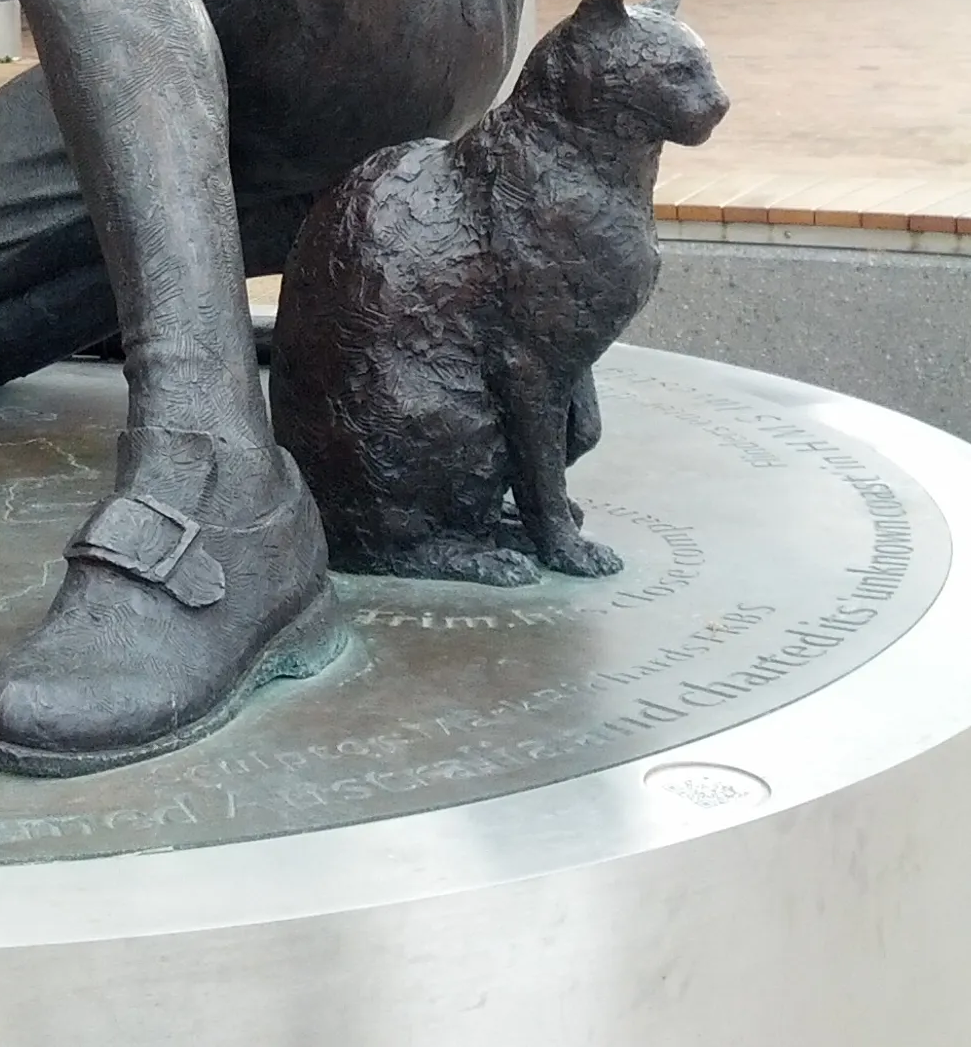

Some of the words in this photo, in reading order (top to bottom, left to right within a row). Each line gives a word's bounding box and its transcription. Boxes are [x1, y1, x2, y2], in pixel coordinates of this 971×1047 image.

[612, 568, 702, 609] close
[680, 629, 841, 711] charted
[798, 605, 878, 635] its
